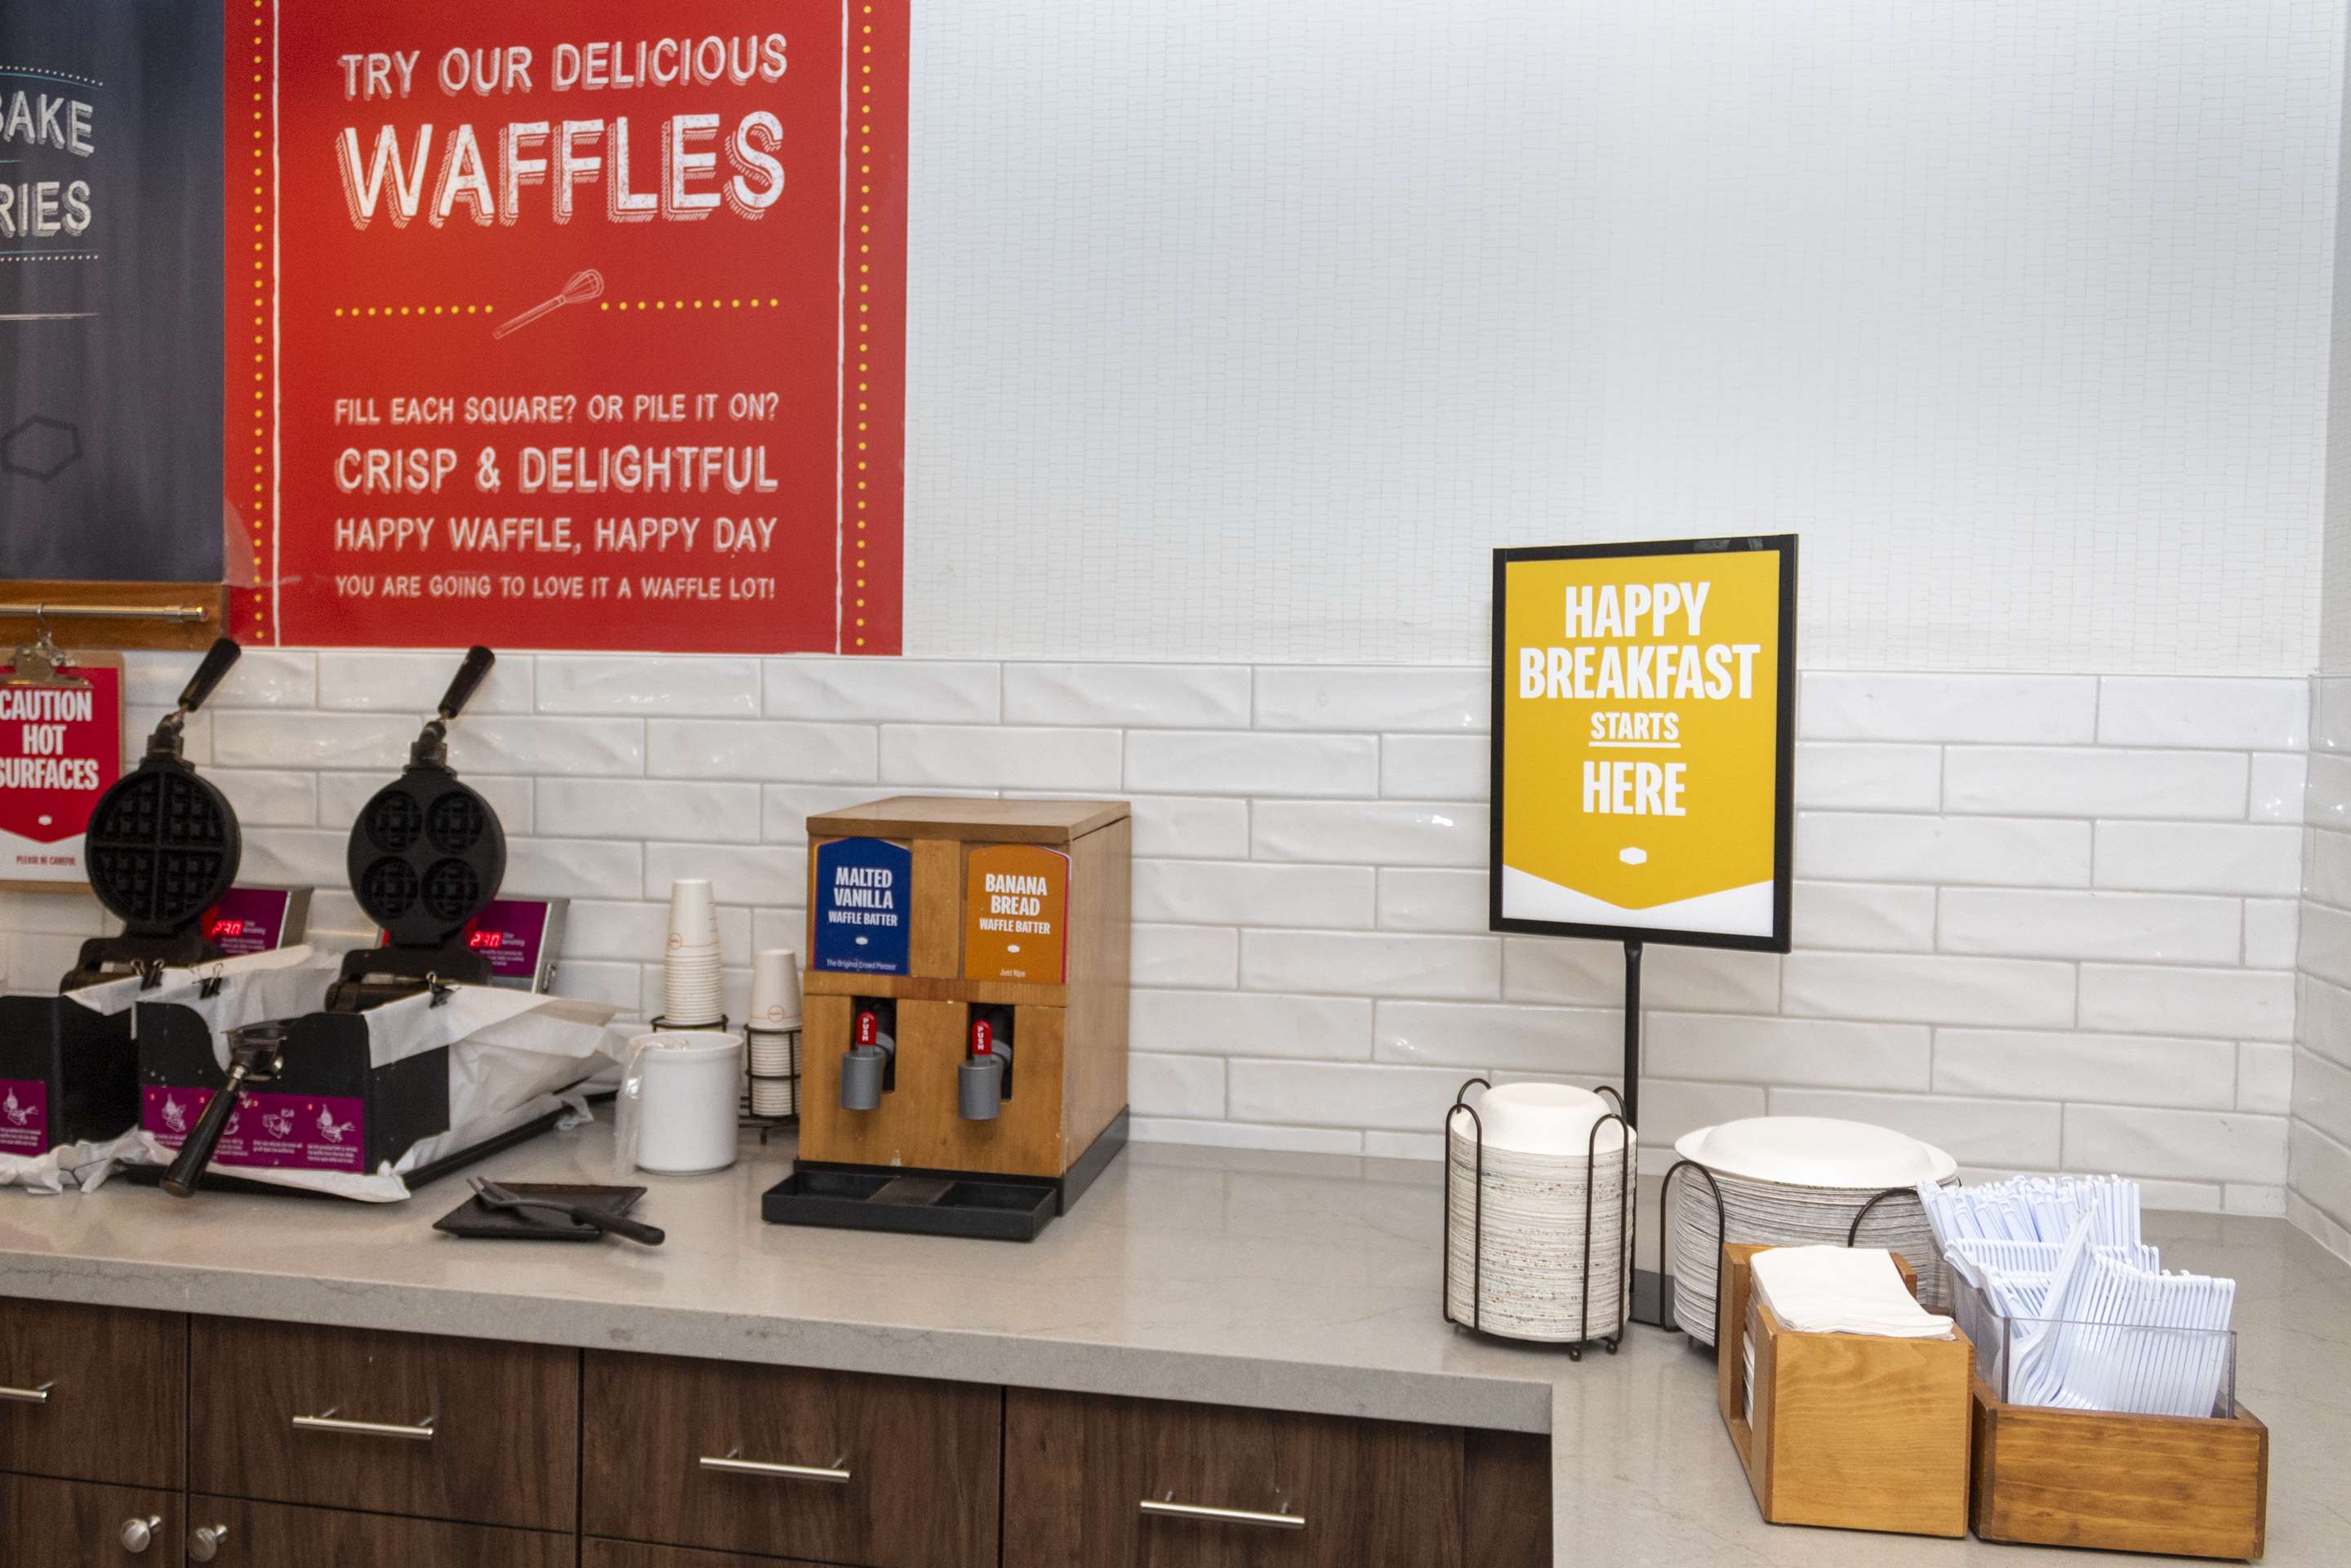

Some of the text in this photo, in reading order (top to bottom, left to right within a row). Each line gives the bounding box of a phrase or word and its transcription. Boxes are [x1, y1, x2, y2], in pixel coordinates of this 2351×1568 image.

[338, 33, 787, 100] TRY OUR DELICIOUS
[0, 91, 94, 157] AKE
[335, 111, 785, 229] WAFFLES
[335, 392, 779, 425] FILL EACH SQUARE? OR PILE IT ON?
[335, 445, 779, 494] CRISP & DELIGHTFUL
[335, 517, 777, 556] HAPPY WAFFLE, HAPPY DAY
[336, 576, 775, 600] YOU ARE GOING TO LOVE IT A WAFFLE LOT!
[1565, 581, 1711, 639] HAPPY
[1519, 644, 1761, 700] BREAKFAST
[0, 689, 92, 722] CAUTION
[23, 724, 67, 755] HOT
[1591, 710, 1680, 741] STARTS
[1583, 760, 1687, 817] HERE
[835, 866, 893, 889] MALTED
[985, 873, 1048, 897] BANANA
[834, 888, 893, 910] VANILLA
[991, 895, 1040, 917] BREAD
[828, 911, 898, 927] WAFFLE BATTER
[979, 918, 1051, 935] WAFFLE BATTER
